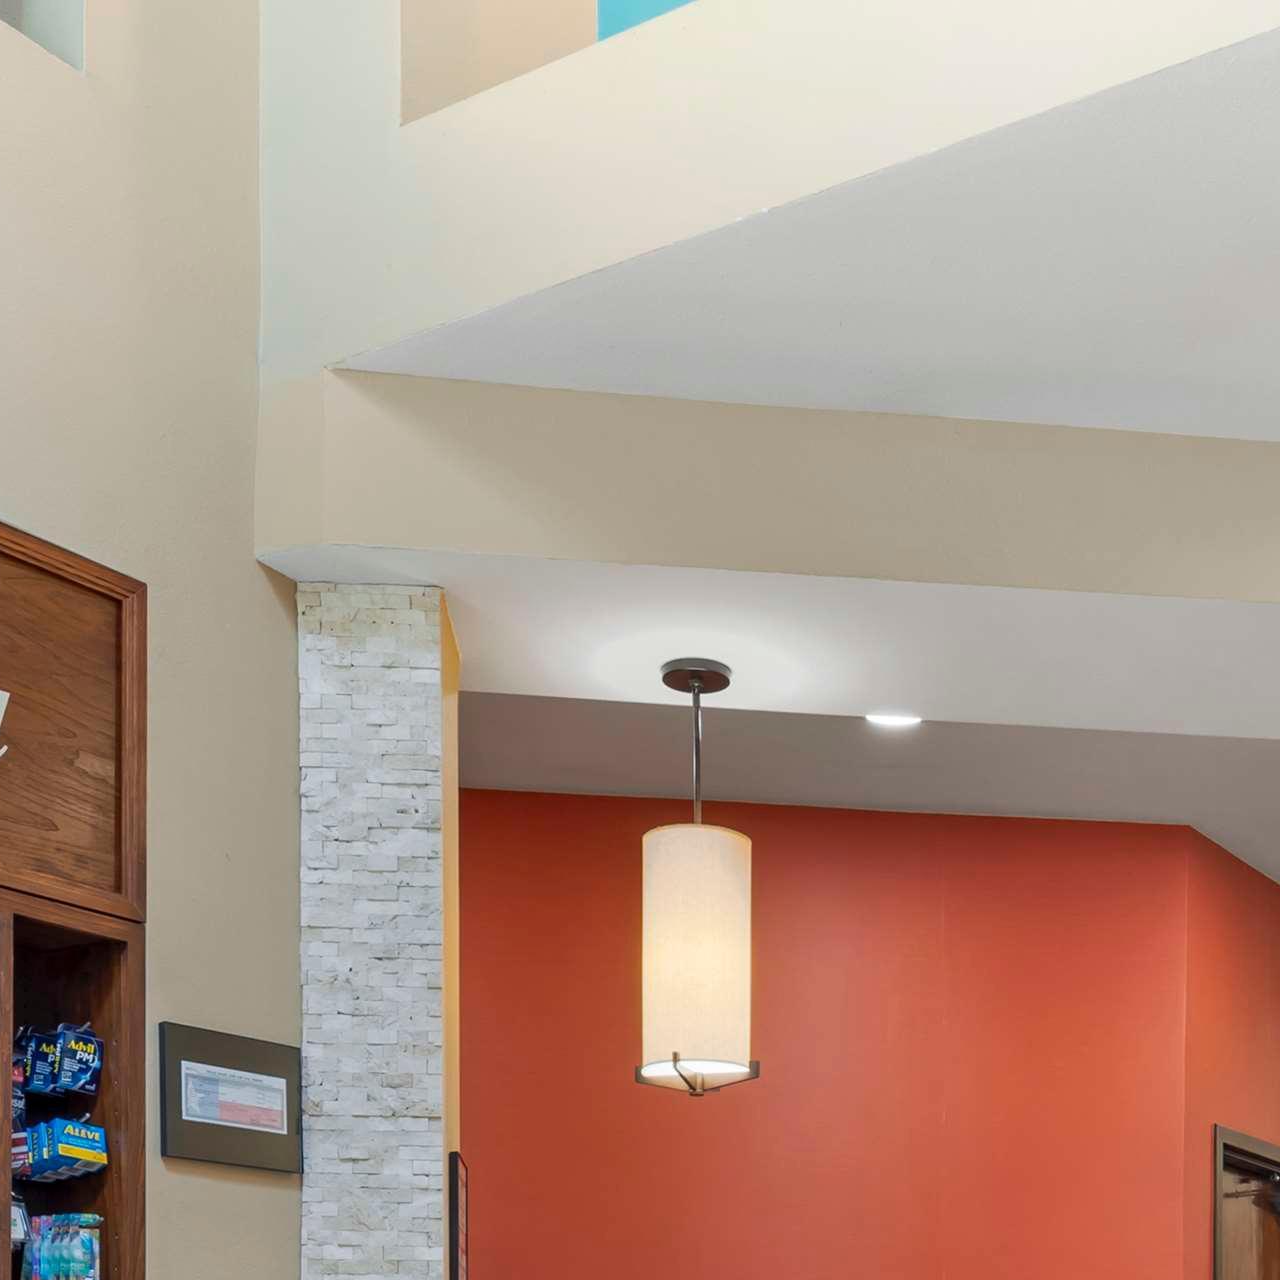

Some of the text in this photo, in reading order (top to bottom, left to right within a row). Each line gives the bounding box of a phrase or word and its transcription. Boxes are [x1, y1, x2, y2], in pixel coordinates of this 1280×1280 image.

[40, 1043, 56, 1054] Adv
[68, 1039, 95, 1053] Advil
[76, 1051, 93, 1065] PM
[64, 1124, 101, 1141] ALEVE
